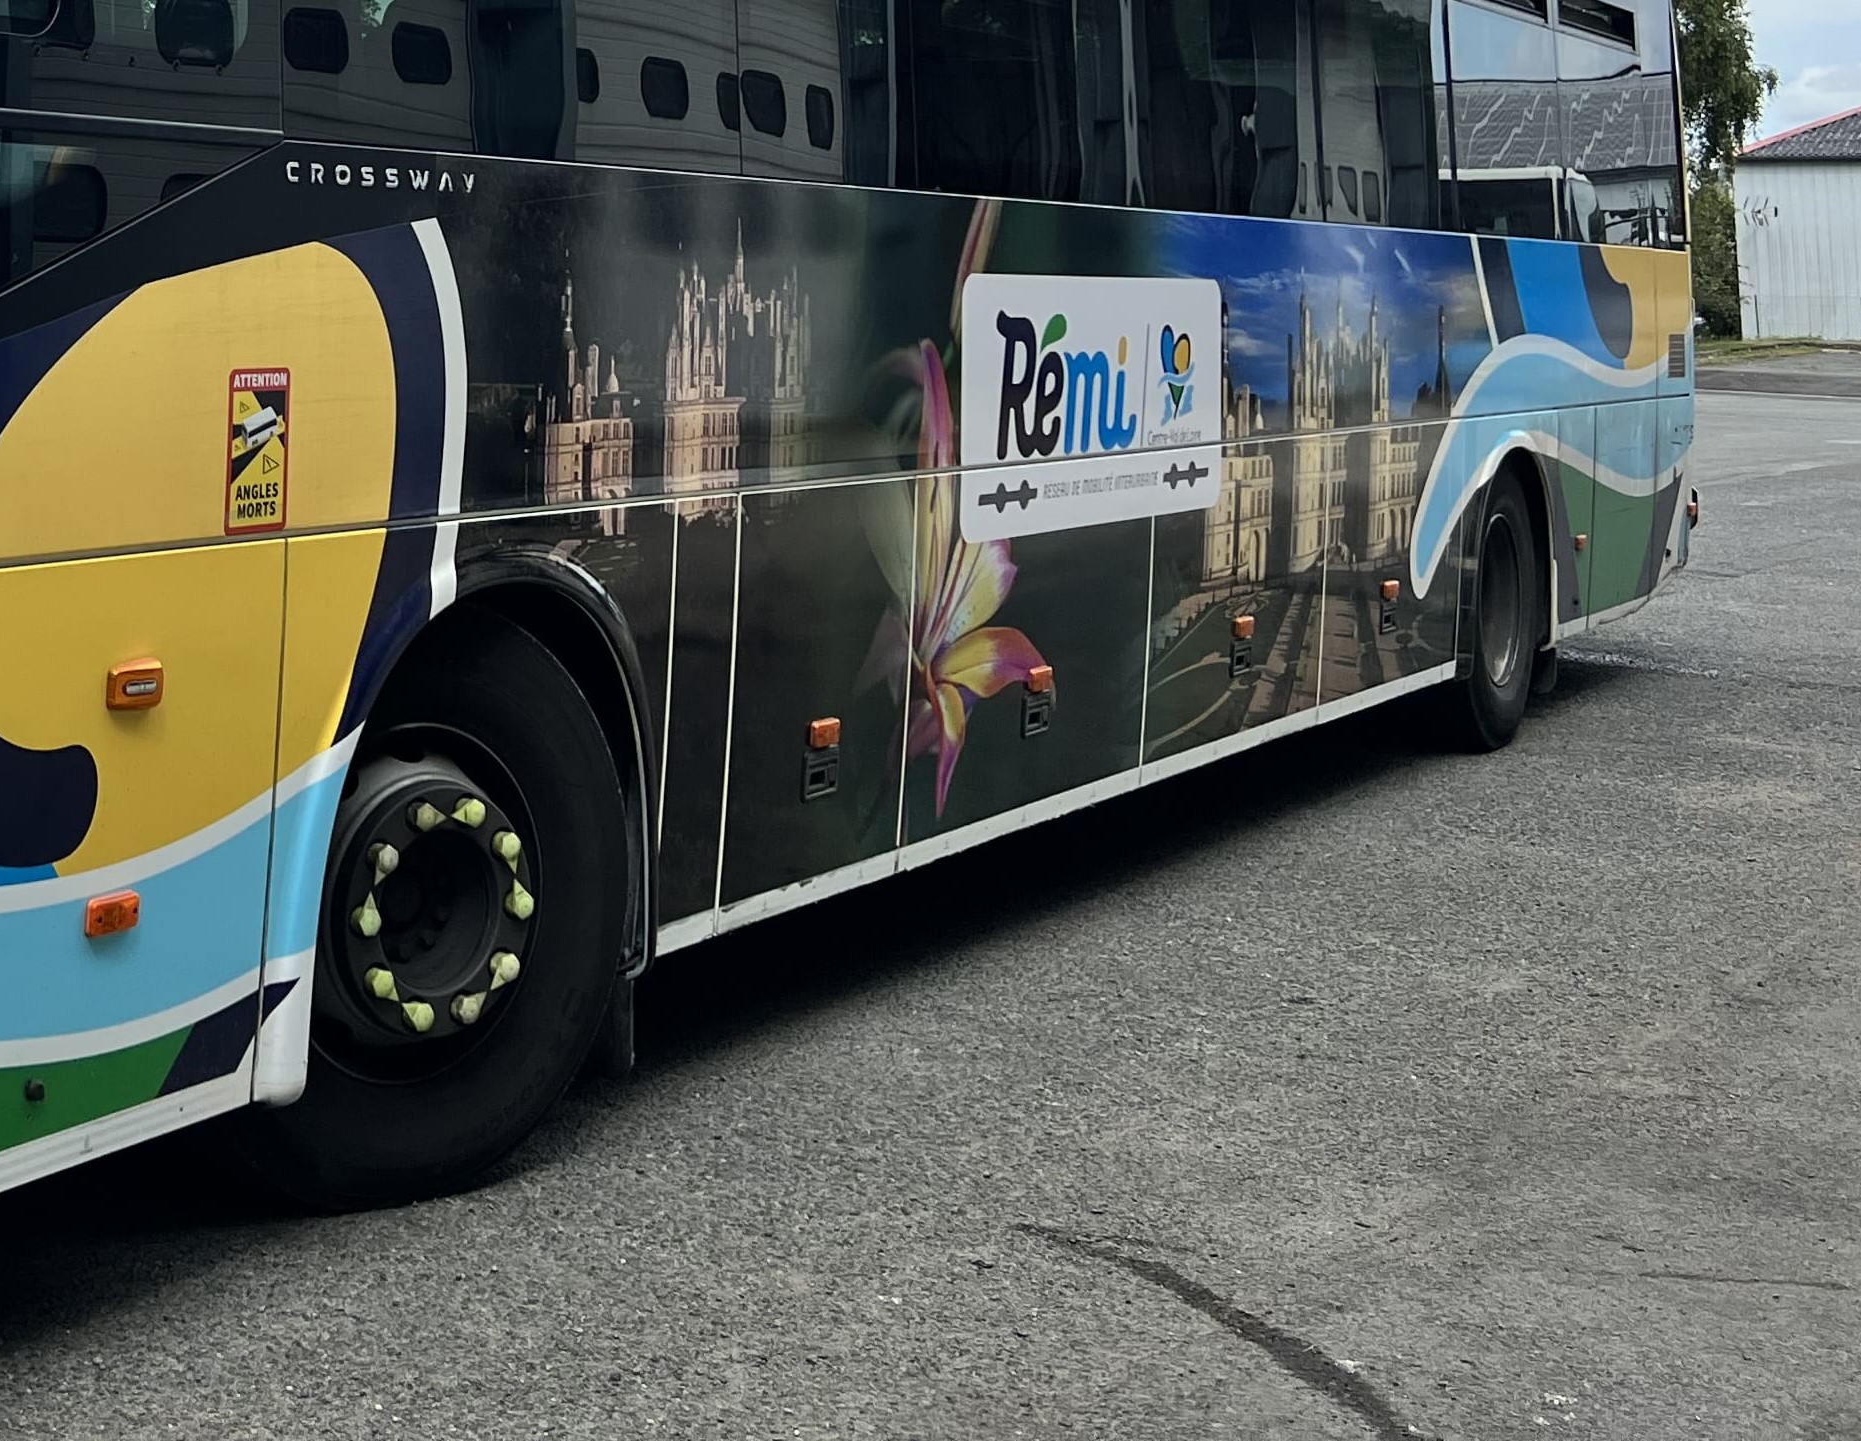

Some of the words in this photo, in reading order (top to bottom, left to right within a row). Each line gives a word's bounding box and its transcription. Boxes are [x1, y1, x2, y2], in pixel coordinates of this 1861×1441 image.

[286, 161, 475, 193] CROSSWAY
[233, 372, 288, 388] ATTENTION
[996, 310, 1137, 460] Rémi
[235, 482, 279, 501] ANGLES
[237, 501, 276, 519] MORTS
